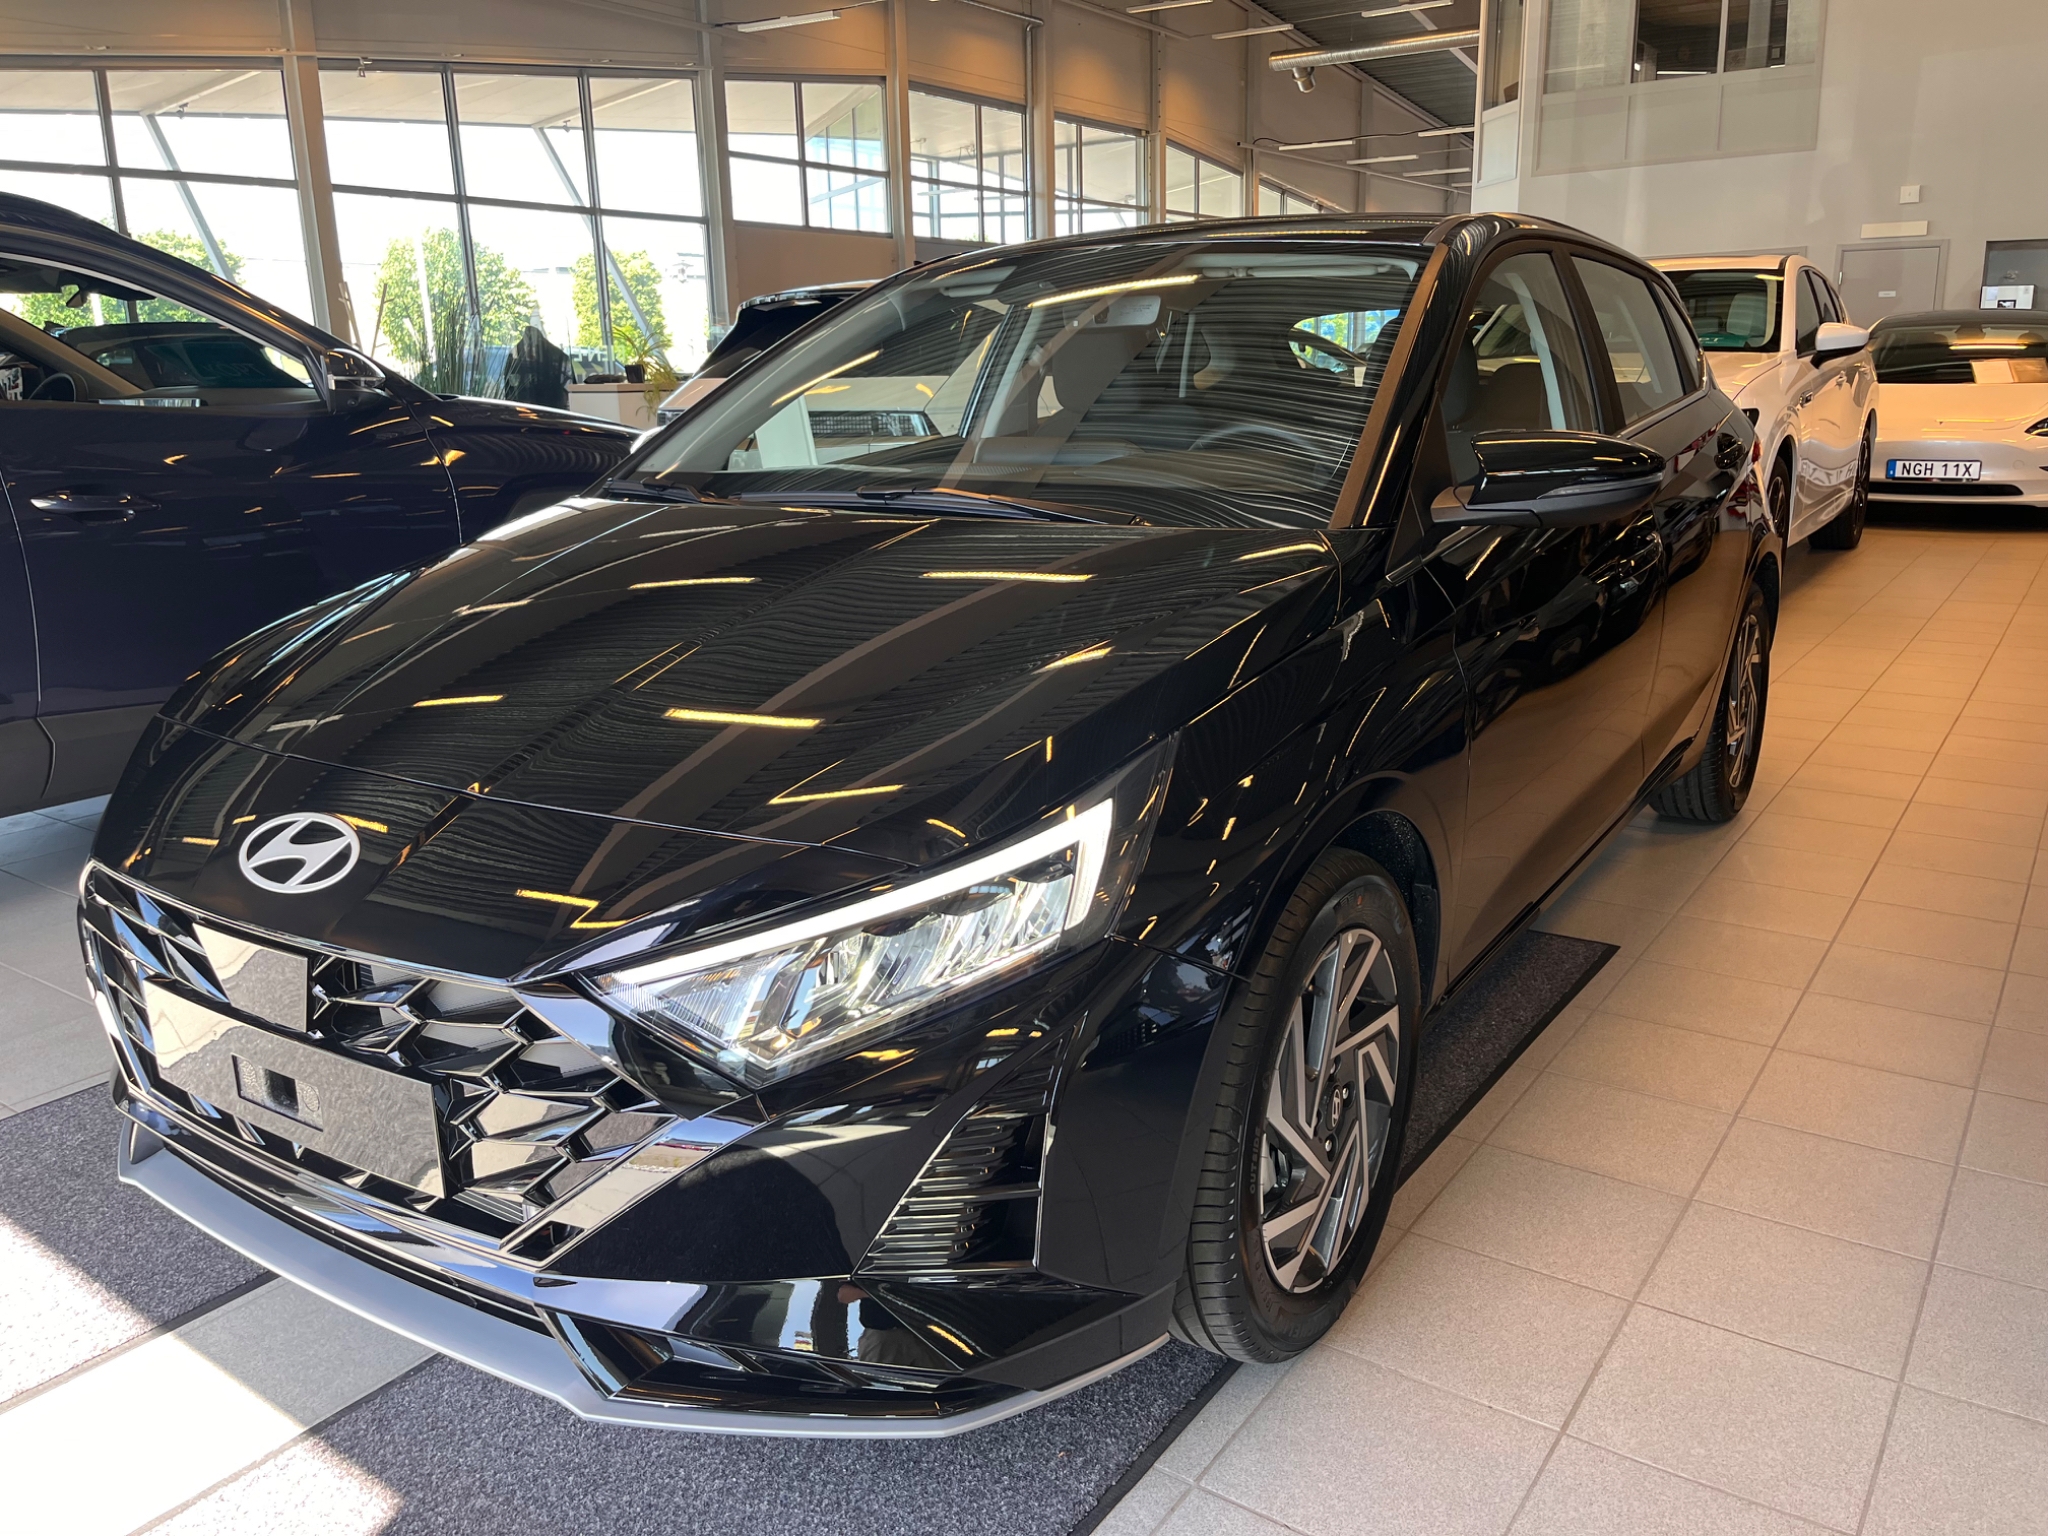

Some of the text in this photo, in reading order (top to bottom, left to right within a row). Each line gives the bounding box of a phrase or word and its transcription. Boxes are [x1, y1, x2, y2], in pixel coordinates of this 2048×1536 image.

[1901, 462, 1973, 477] NGH 11X
[1249, 1126, 1261, 1194] OUTSIDE
